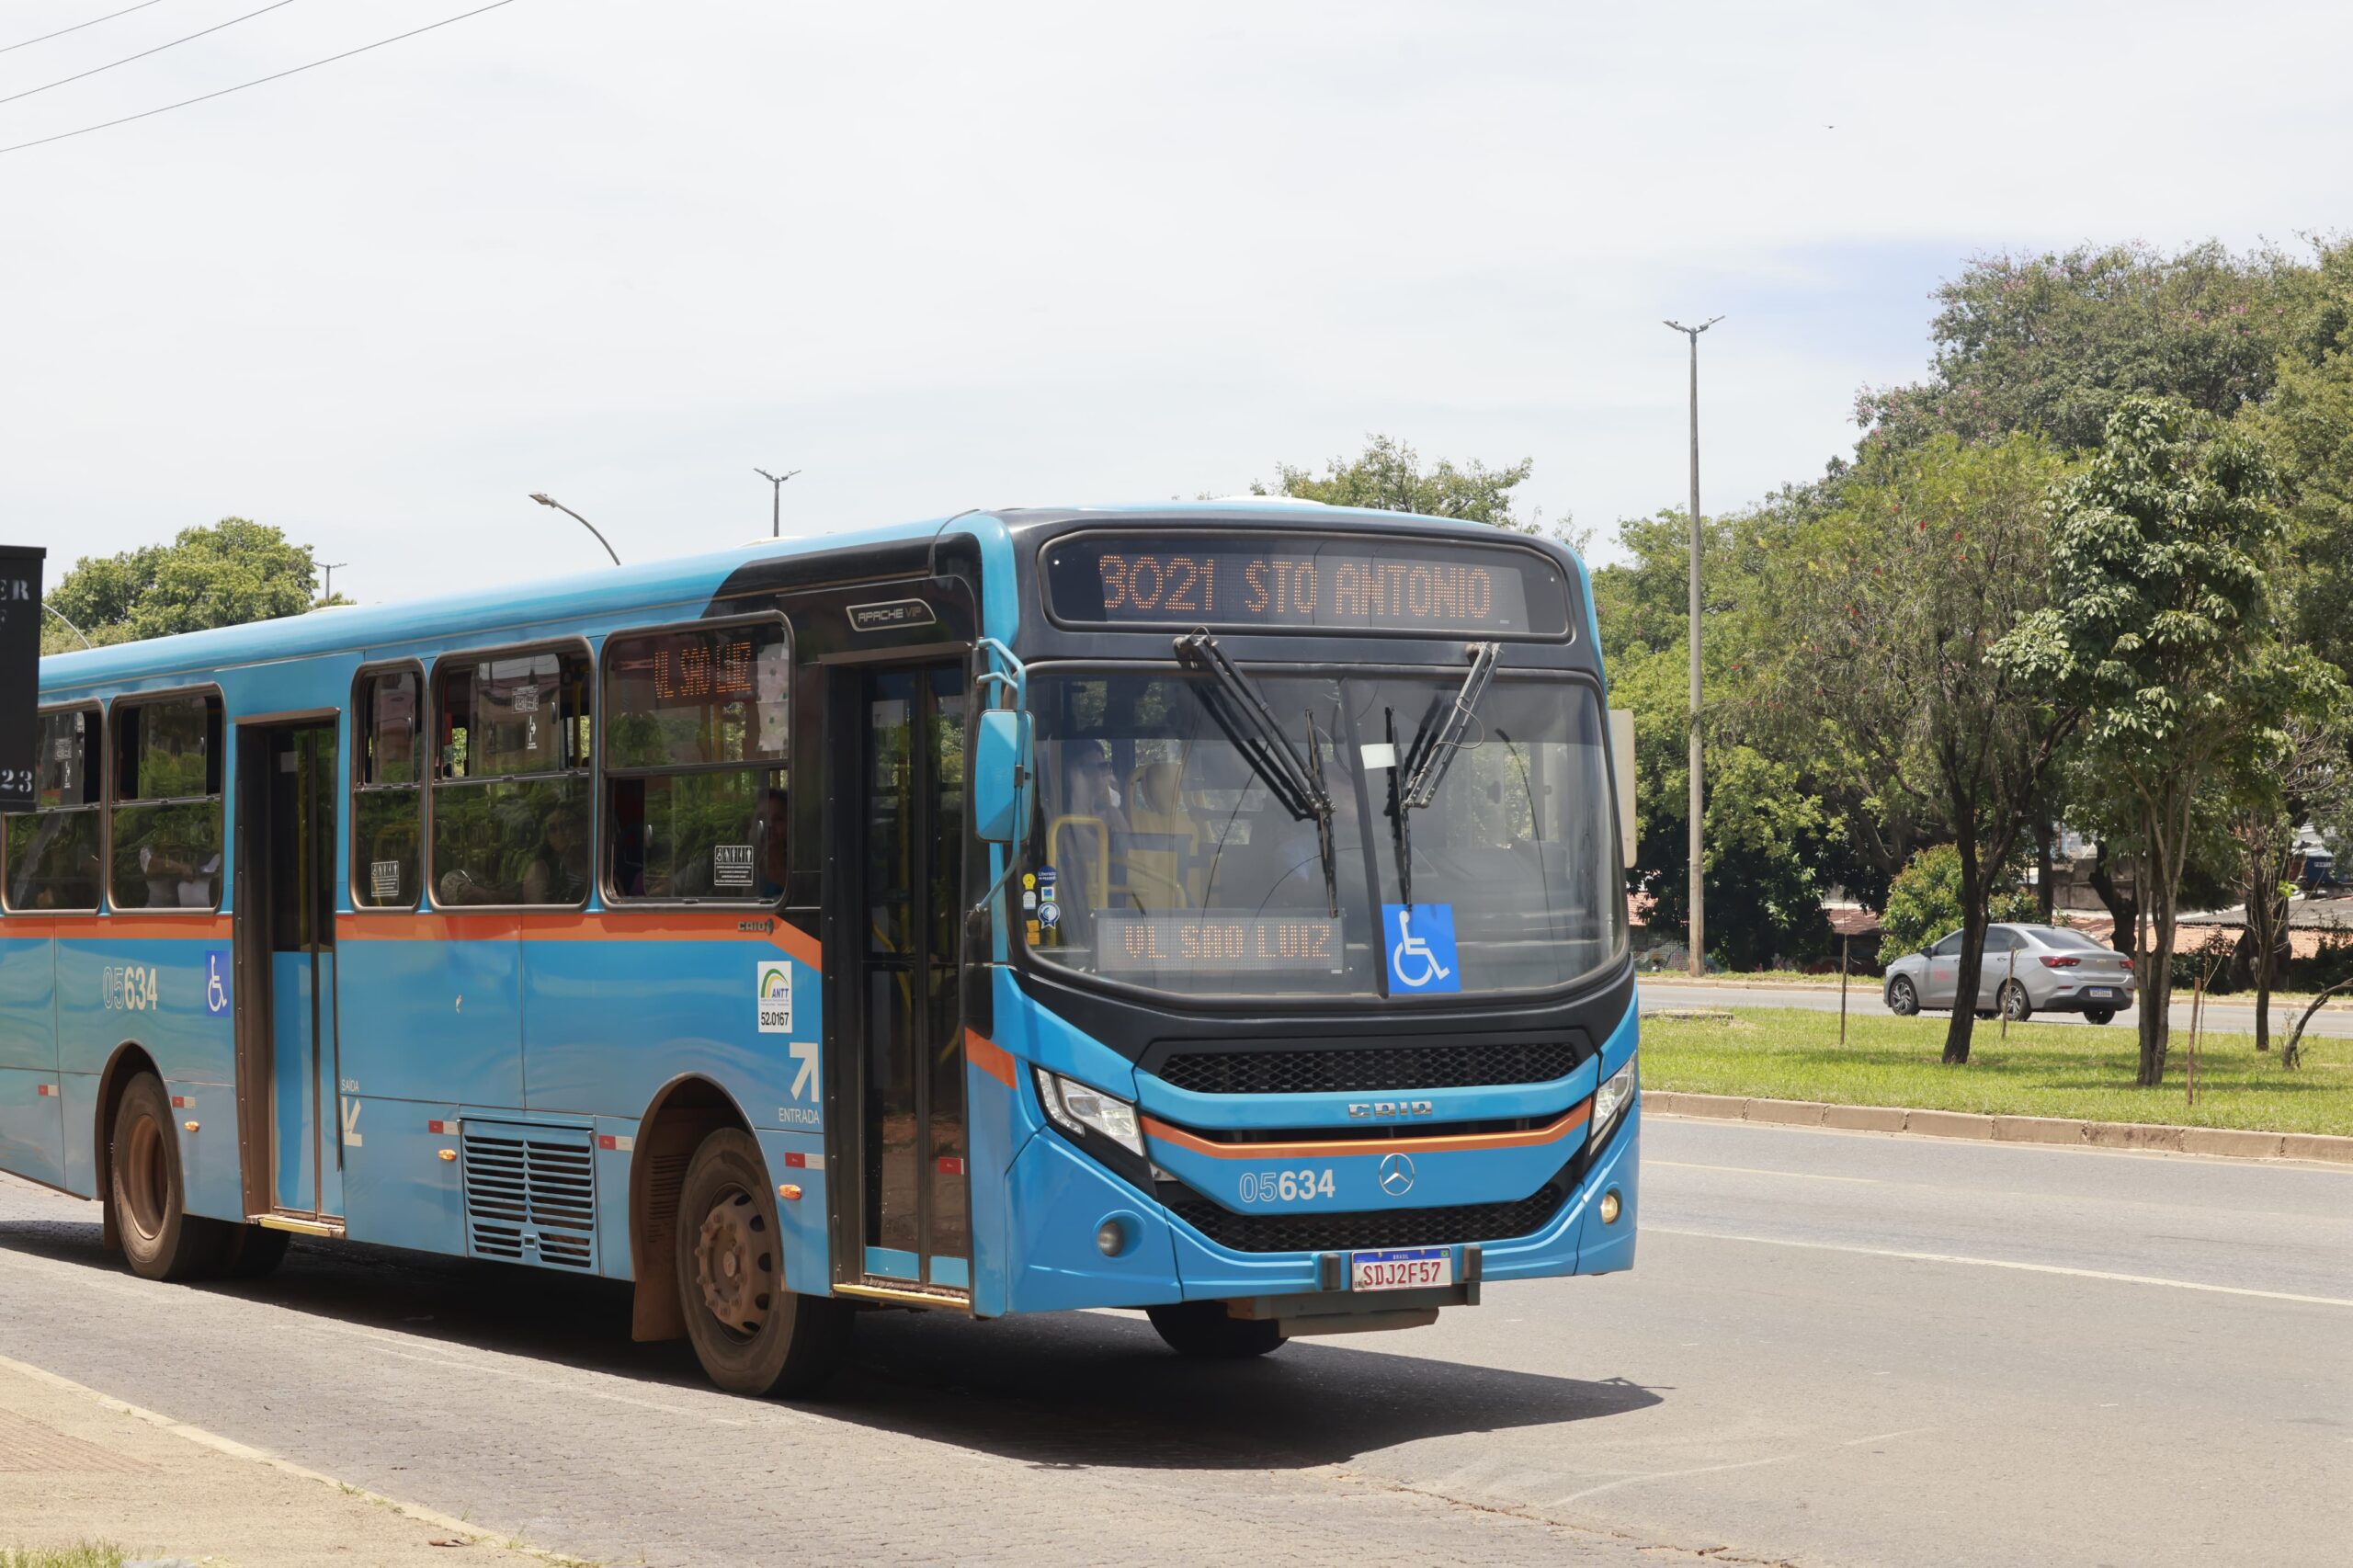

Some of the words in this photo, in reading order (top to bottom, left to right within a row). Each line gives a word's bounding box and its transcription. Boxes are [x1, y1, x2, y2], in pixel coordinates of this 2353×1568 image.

[1245, 560, 1319, 614] STO
[1335, 562, 1492, 619] ANTONIO
[858, 608, 904, 623] APACHE
[737, 920, 766, 931] CAIO
[1125, 925, 1166, 960] VL
[1257, 924, 1331, 958] LUIZ
[103, 966, 158, 1010] 05634
[771, 988, 790, 999] ANTT
[760, 1011, 790, 1027] 52.0167
[779, 1107, 821, 1125] ENTRADA
[1348, 1101, 1432, 1118] CAIO
[1239, 1168, 1336, 1203] 05634
[1363, 1261, 1441, 1286] SDJ2F57
